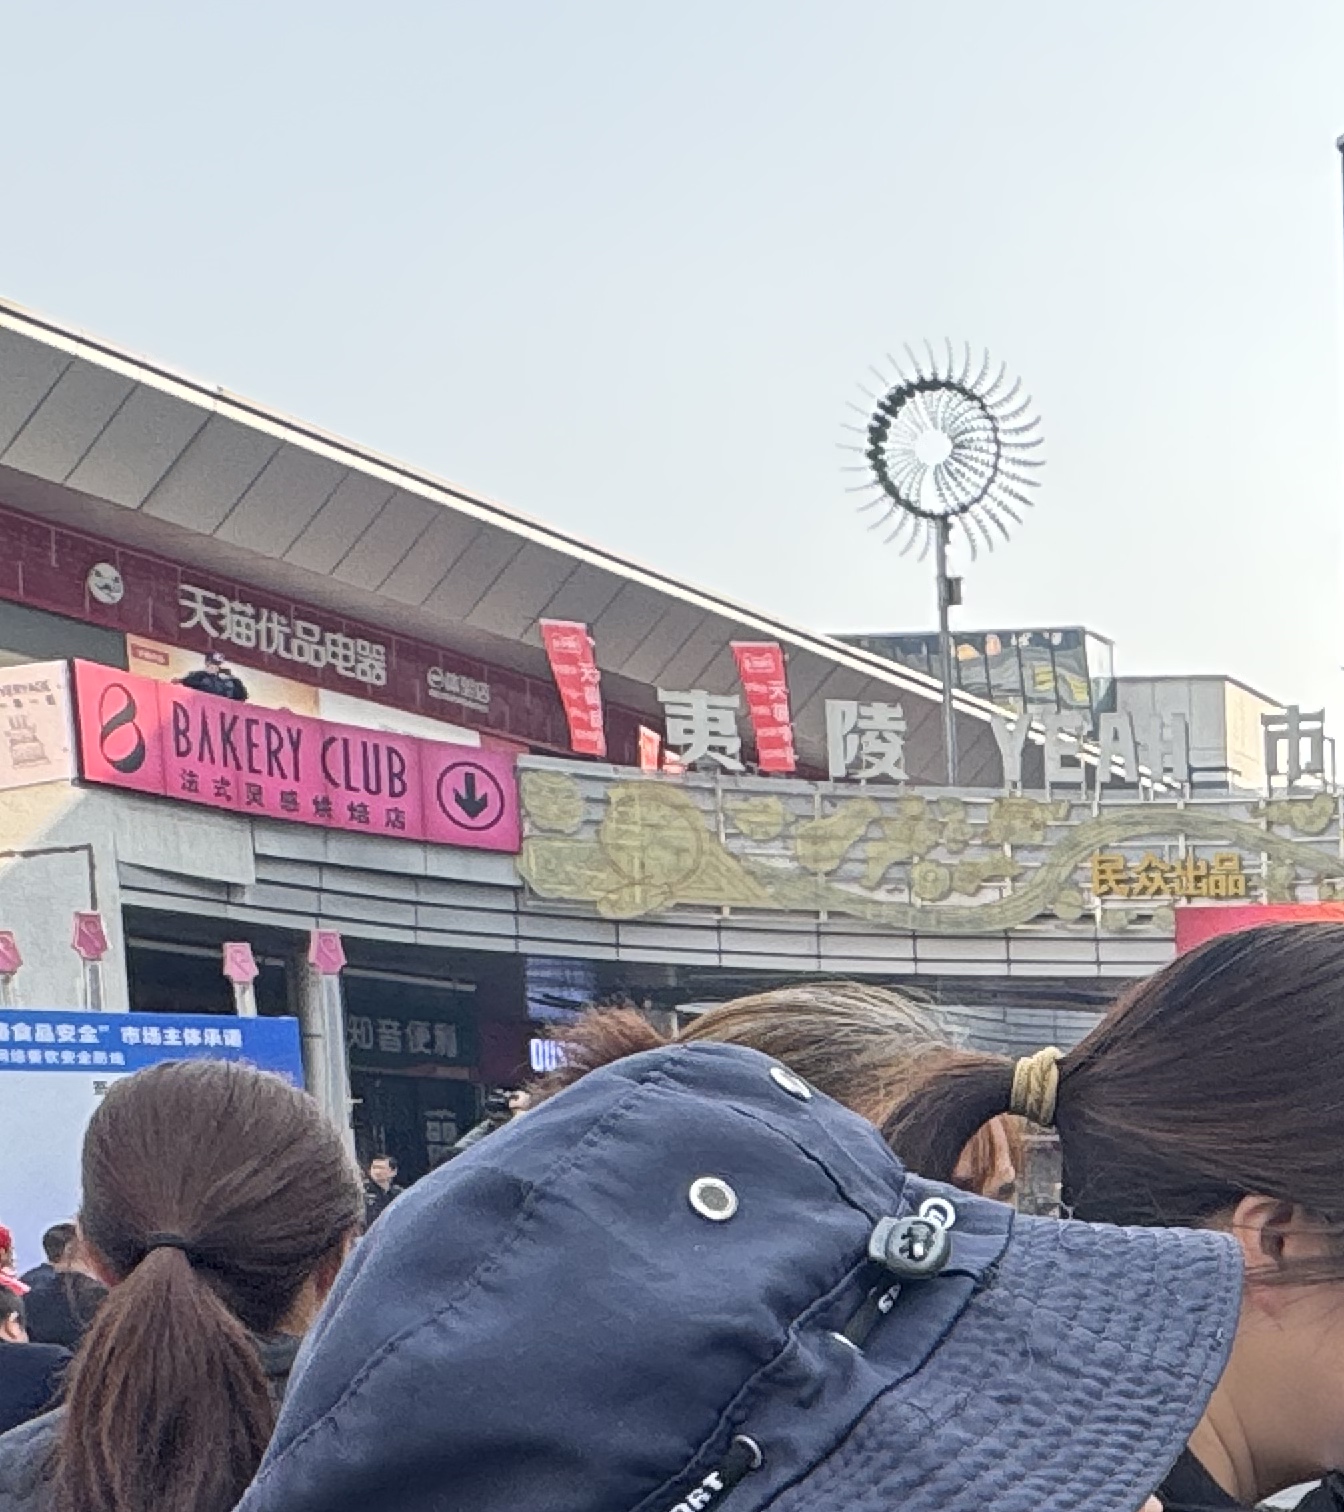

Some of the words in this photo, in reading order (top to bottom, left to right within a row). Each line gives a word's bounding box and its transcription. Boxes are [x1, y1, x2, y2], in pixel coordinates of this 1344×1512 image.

[179, 584, 388, 687] 天猫优品电器
[172, 701, 302, 783] BAKERY
[320, 736, 407, 798] CLUB
[657, 687, 909, 782] 夷陵
[991, 711, 1189, 783] YEAH
[180, 770, 406, 832] 法式灵感烘焙店
[1090, 850, 1248, 898] 民众出品
